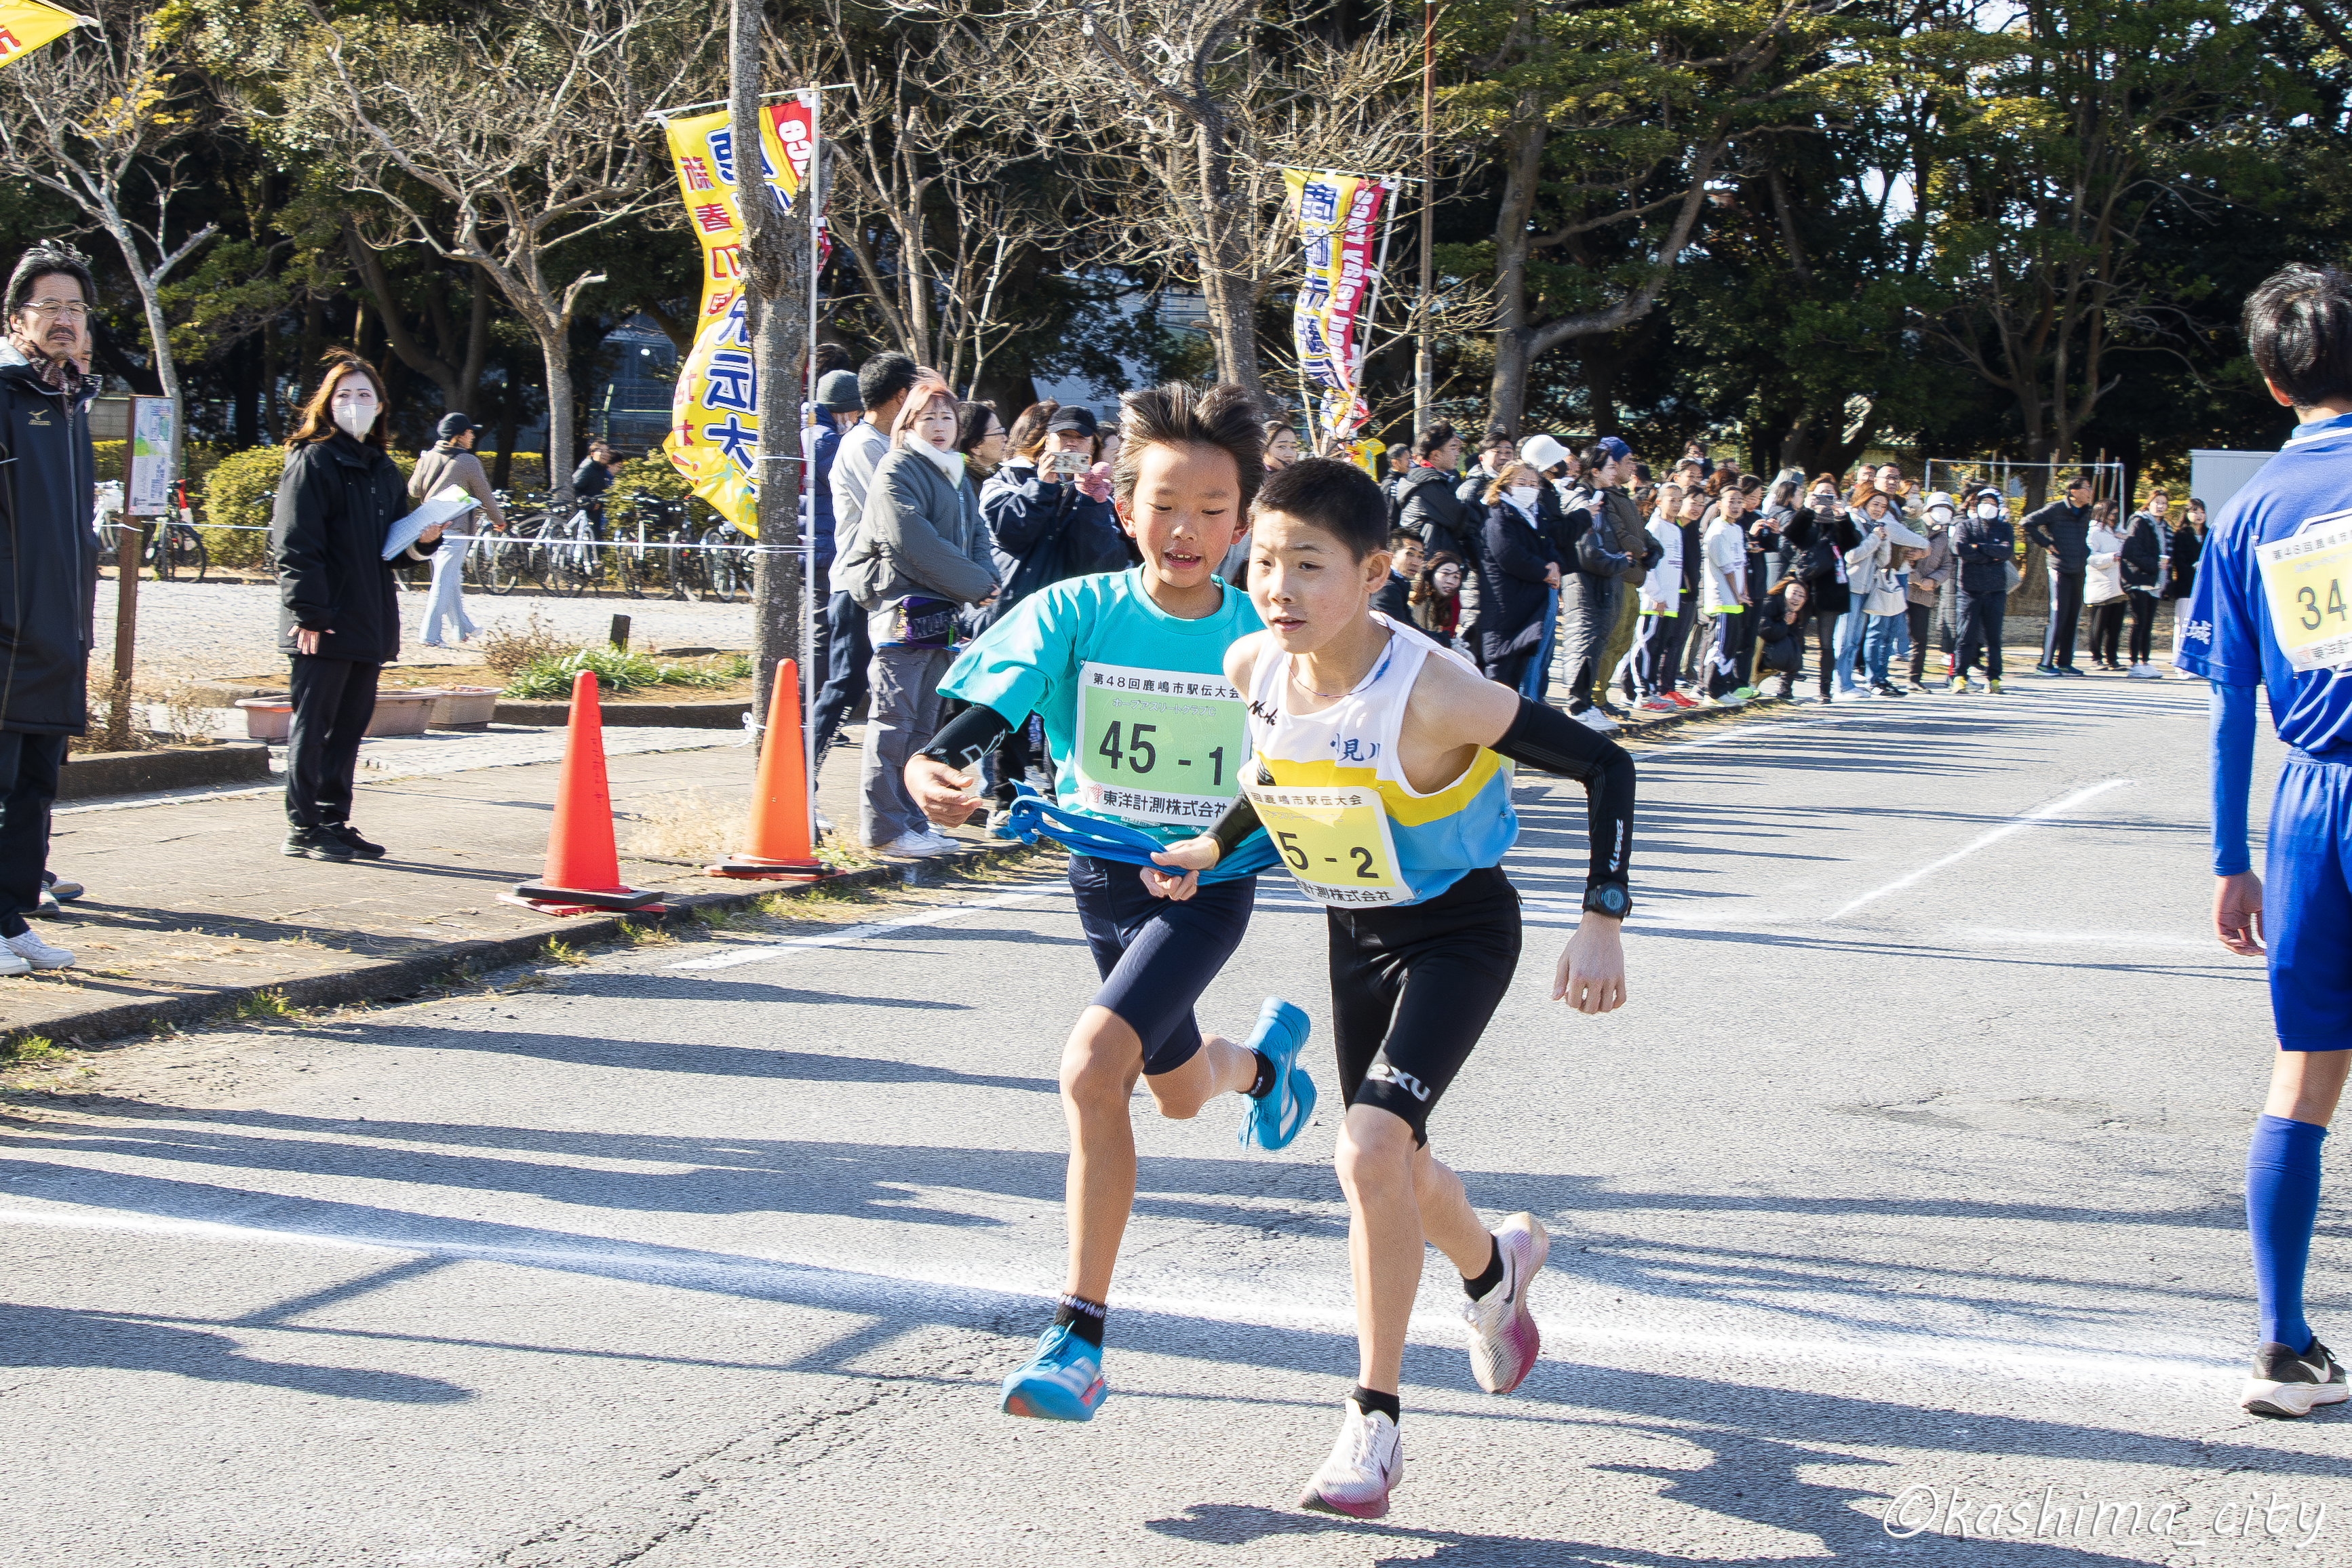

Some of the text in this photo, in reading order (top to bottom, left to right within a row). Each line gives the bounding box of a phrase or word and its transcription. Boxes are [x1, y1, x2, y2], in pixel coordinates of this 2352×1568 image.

[2296, 579, 2347, 630] 34
[1099, 720, 1156, 773] 45
[1209, 747, 1223, 785] 1
[1350, 847, 1379, 879] 2
[1293, 878, 1394, 902] 計測株式会社
[1367, 1063, 1431, 1101] 2XU
